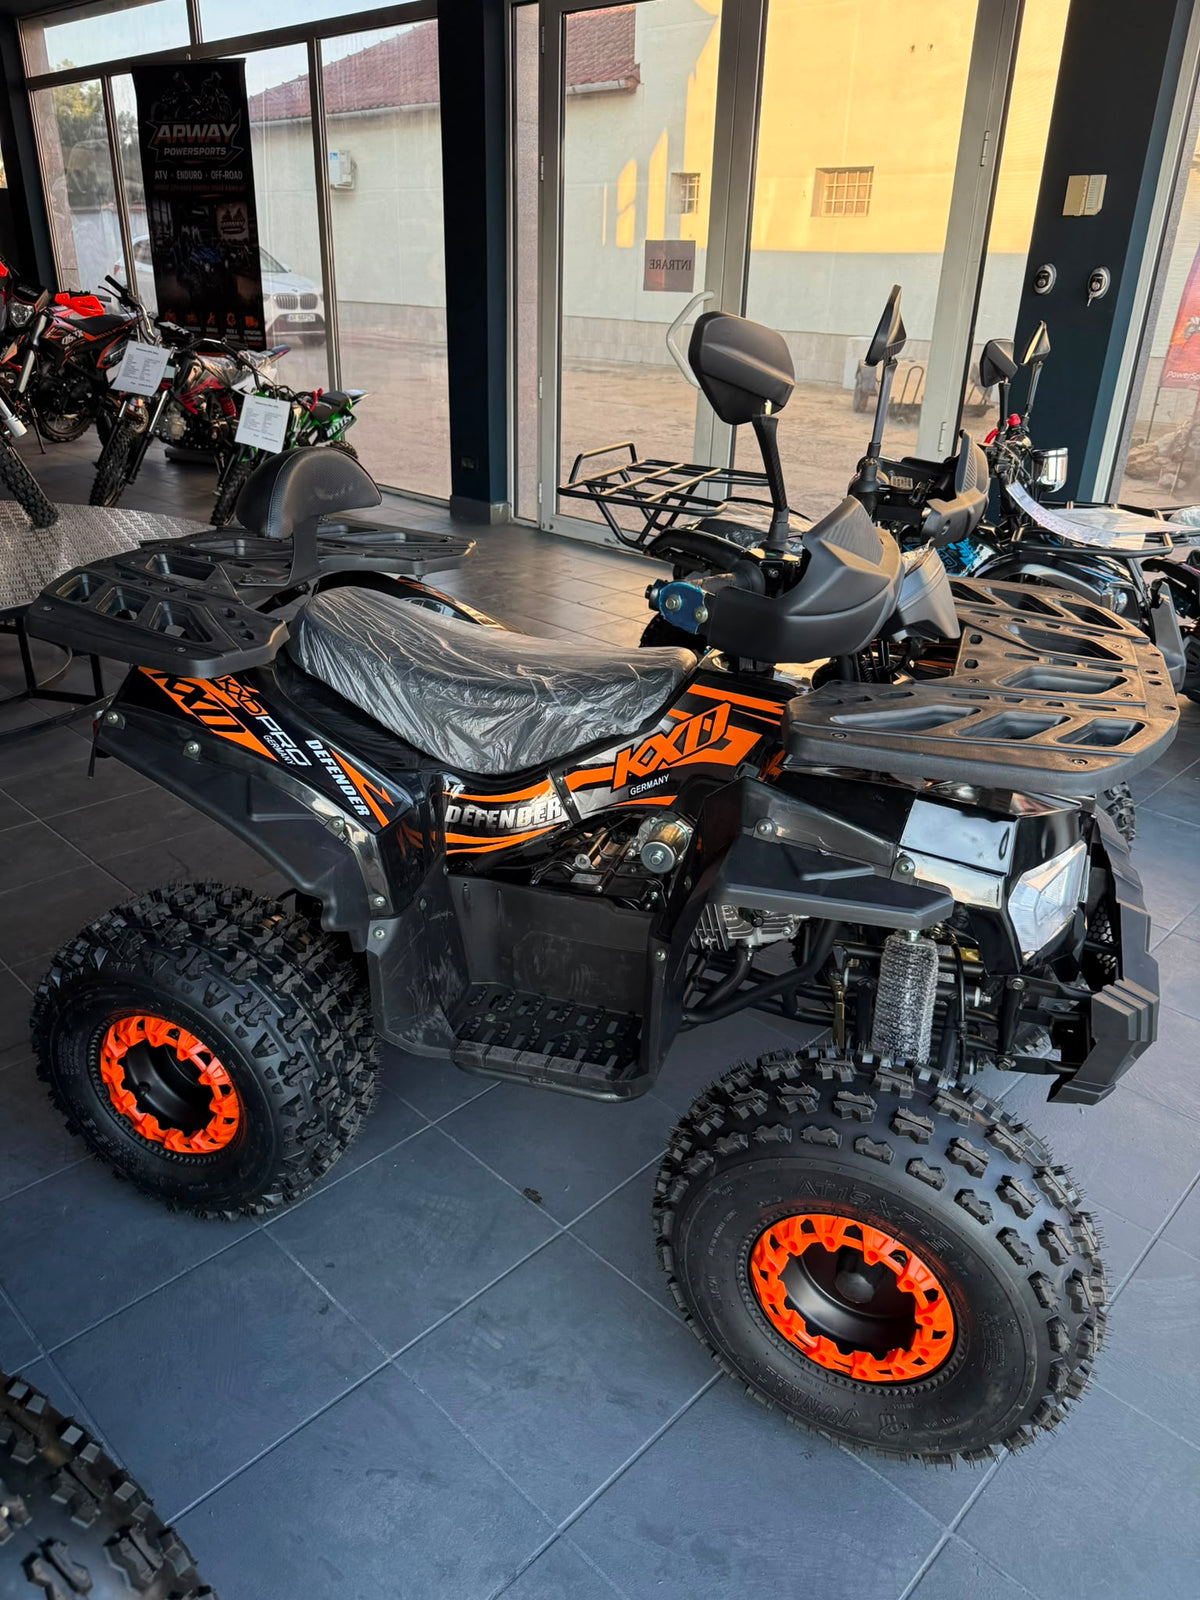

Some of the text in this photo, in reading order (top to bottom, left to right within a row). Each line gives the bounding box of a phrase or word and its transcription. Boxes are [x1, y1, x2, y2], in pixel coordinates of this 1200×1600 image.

[164, 147, 227, 156] POWERSPORTS
[154, 170, 244, 181] ATV ENDURO OFF-ROAD
[256, 716, 312, 767] PRO
[263, 734, 296, 766] GERMANY
[612, 701, 732, 790] KXD
[305, 739, 370, 817] DEFENDER
[630, 773, 670, 797] GERMANY
[446, 796, 564, 830] DEFENDER
